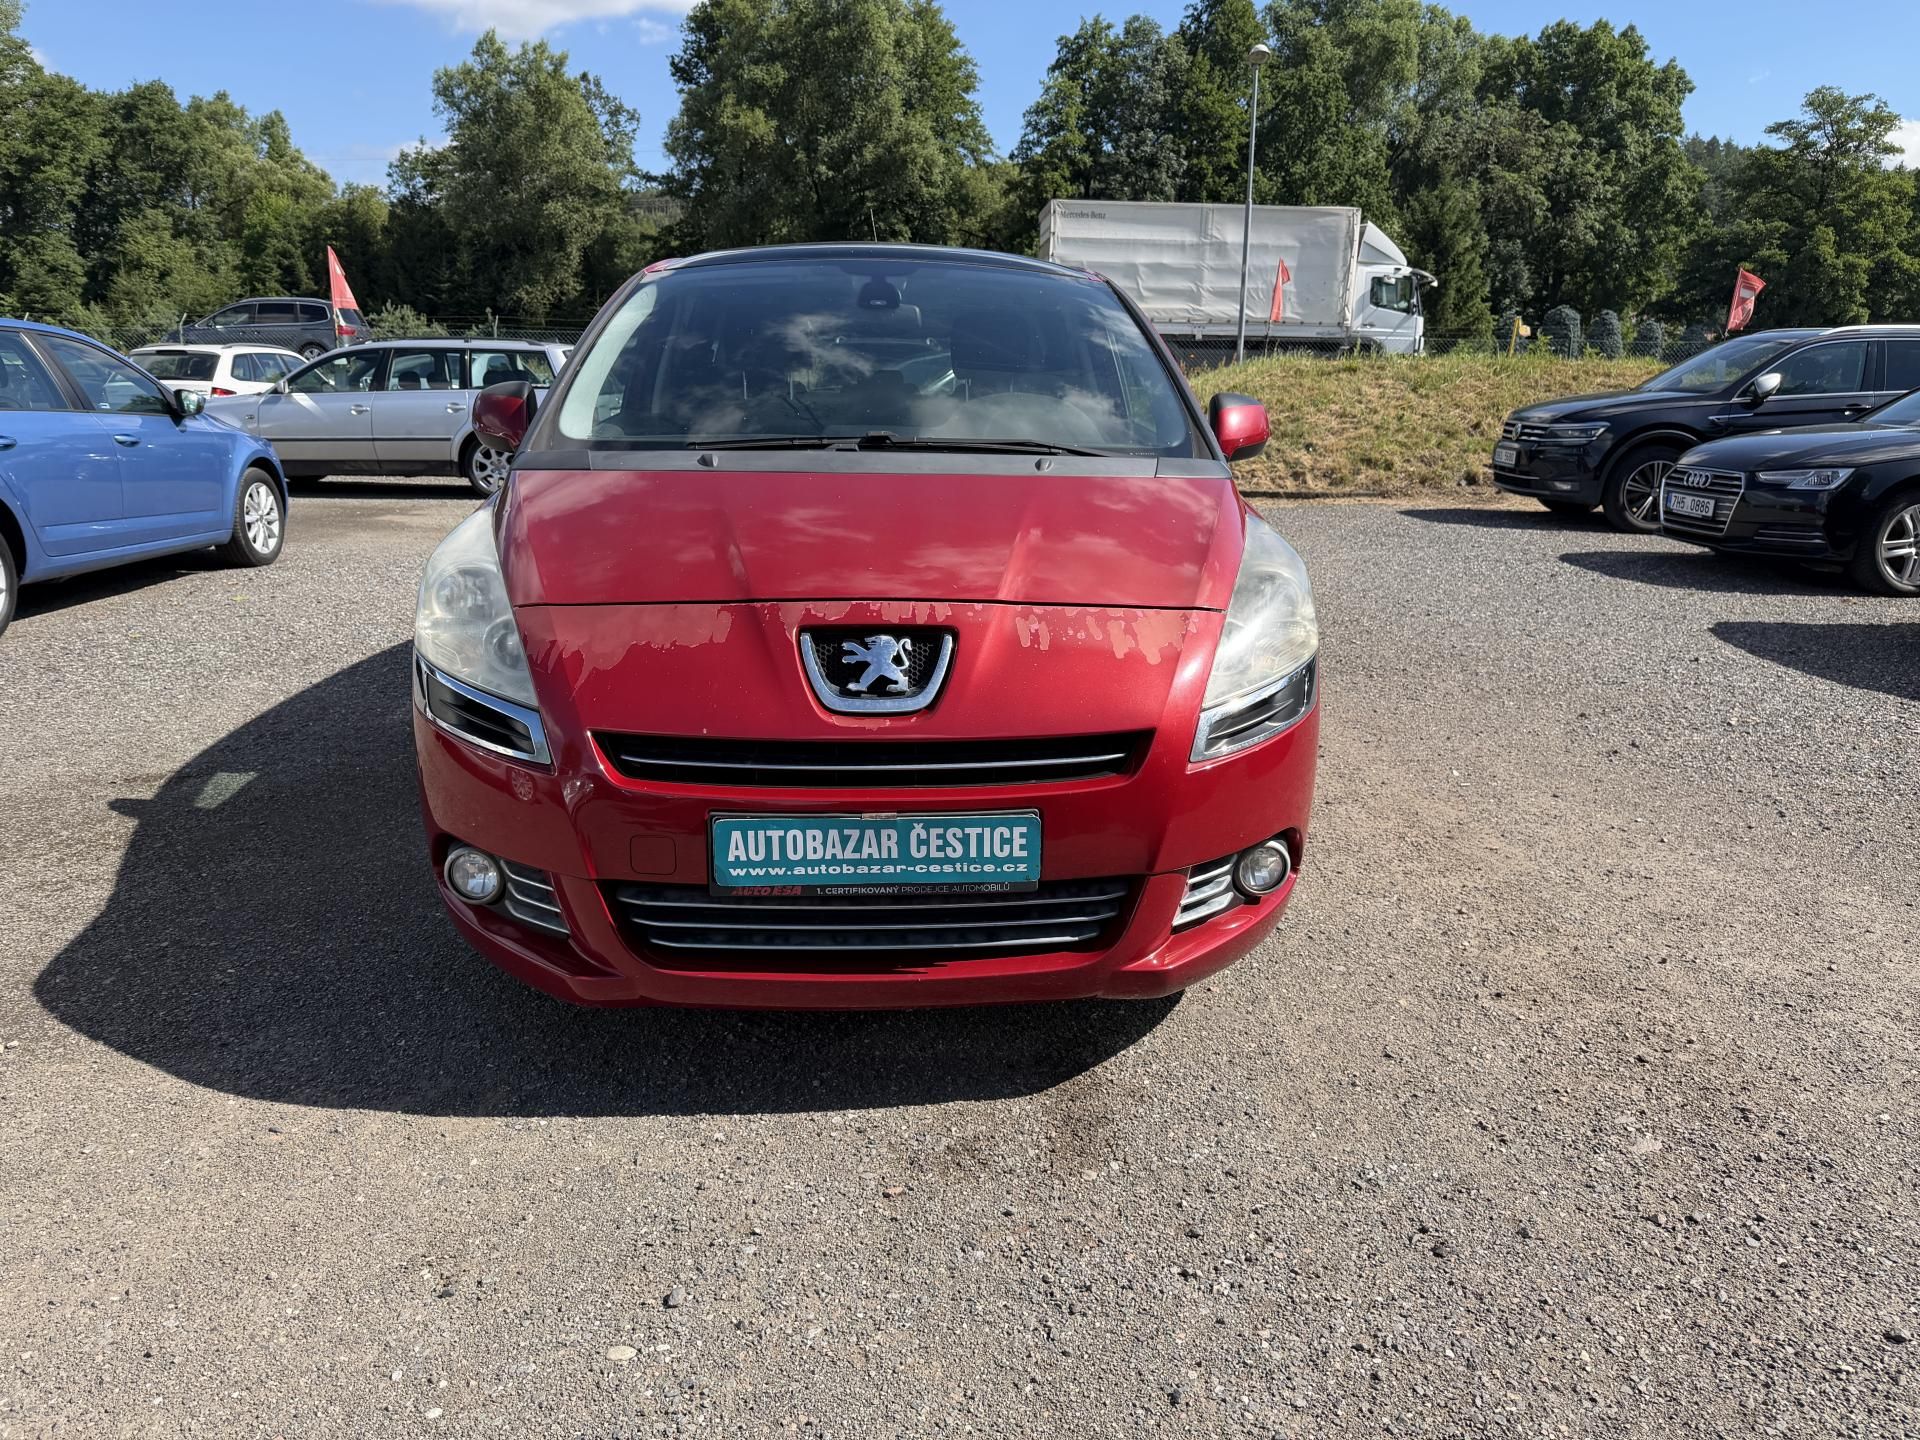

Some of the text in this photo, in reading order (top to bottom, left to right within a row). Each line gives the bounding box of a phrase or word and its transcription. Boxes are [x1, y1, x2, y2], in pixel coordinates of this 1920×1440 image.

[1672, 495, 1711, 514] 7H5 0886
[727, 823, 1028, 862] AUTOBAZAR ČESTICE
[728, 862, 1028, 876] www.autobazar-cestice.cz
[825, 885, 899, 895] CERTIFIKOVANÝ
[951, 882, 1010, 892] AUTOMOBILŮ
